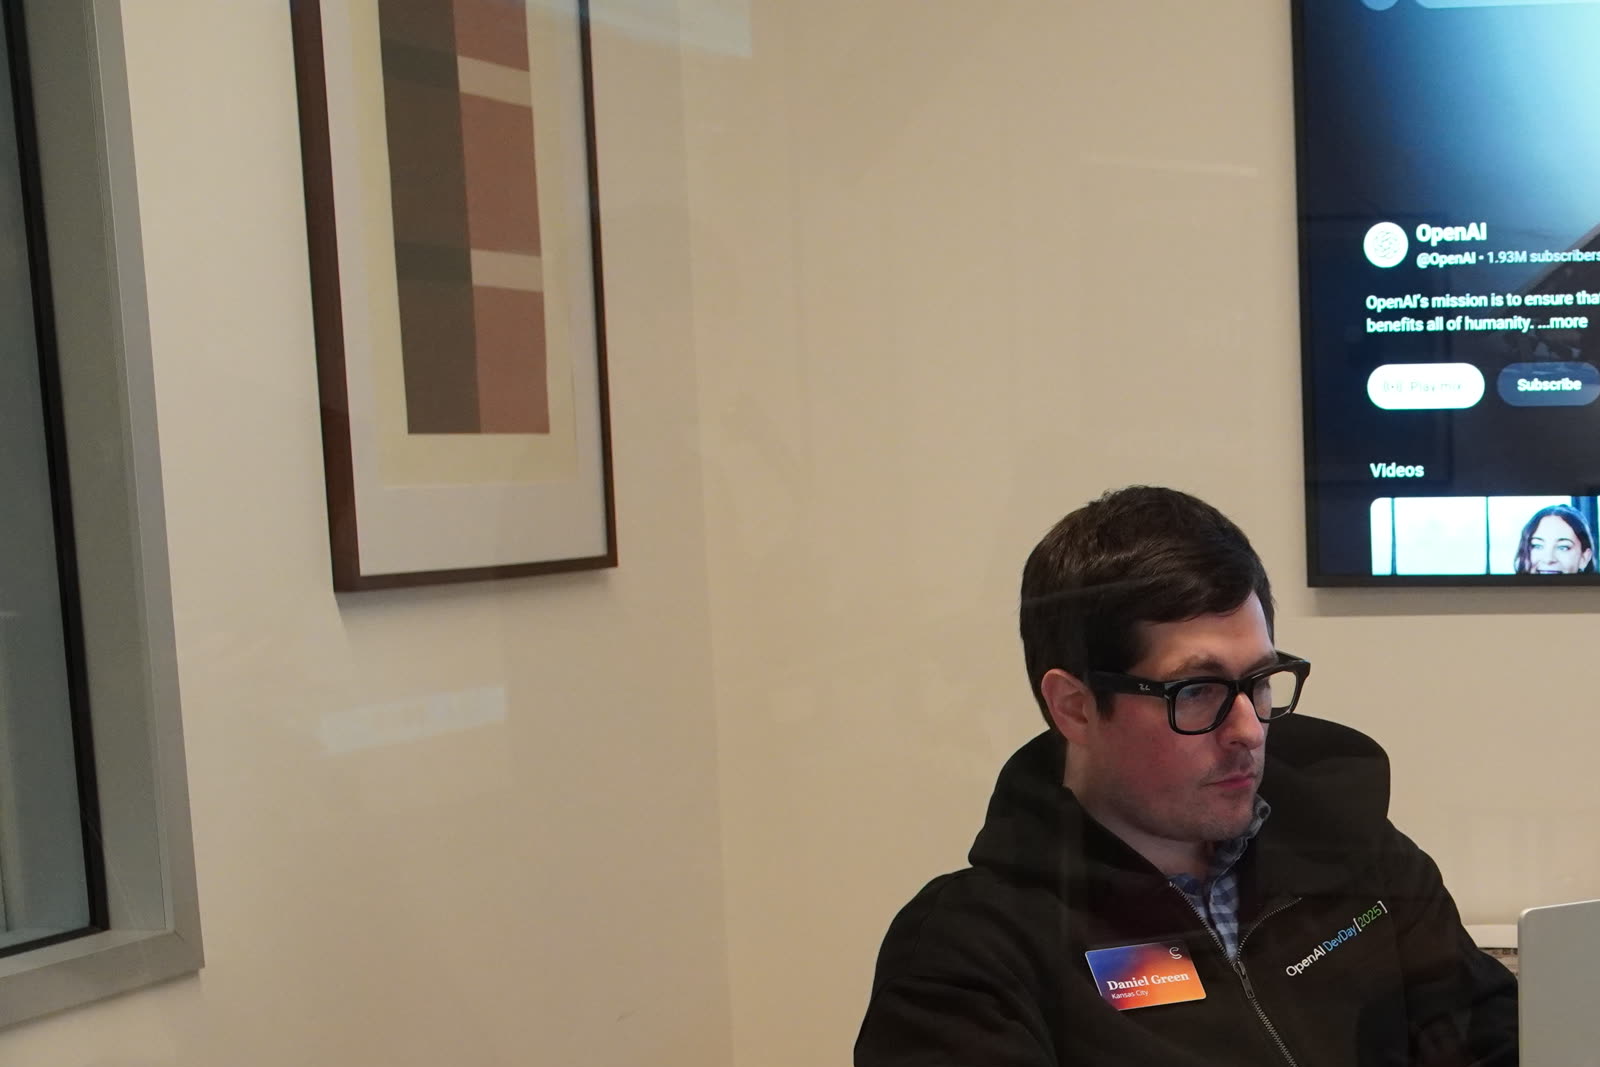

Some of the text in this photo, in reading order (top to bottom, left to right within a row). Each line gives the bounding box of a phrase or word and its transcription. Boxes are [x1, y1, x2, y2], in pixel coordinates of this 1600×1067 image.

[1415, 222, 1488, 247] OpenAI
[1416, 251, 1477, 269] @OpenAI
[1487, 250, 1528, 264] 1.93M
[1431, 293, 1488, 308] mission
[1490, 292, 1505, 307] is
[1506, 292, 1523, 307] to
[1524, 293, 1575, 307] ensure
[1366, 317, 1425, 332] benefits
[1426, 316, 1444, 331] all
[1446, 315, 1463, 331] of
[1464, 315, 1534, 333] humanity.
[1517, 377, 1582, 392] Subscribe
[1369, 462, 1425, 478] Videos
[1285, 945, 1327, 977] OpenAI
[1106, 973, 1190, 991] Daniel Green
[1111, 989, 1149, 1000] Kansas City
